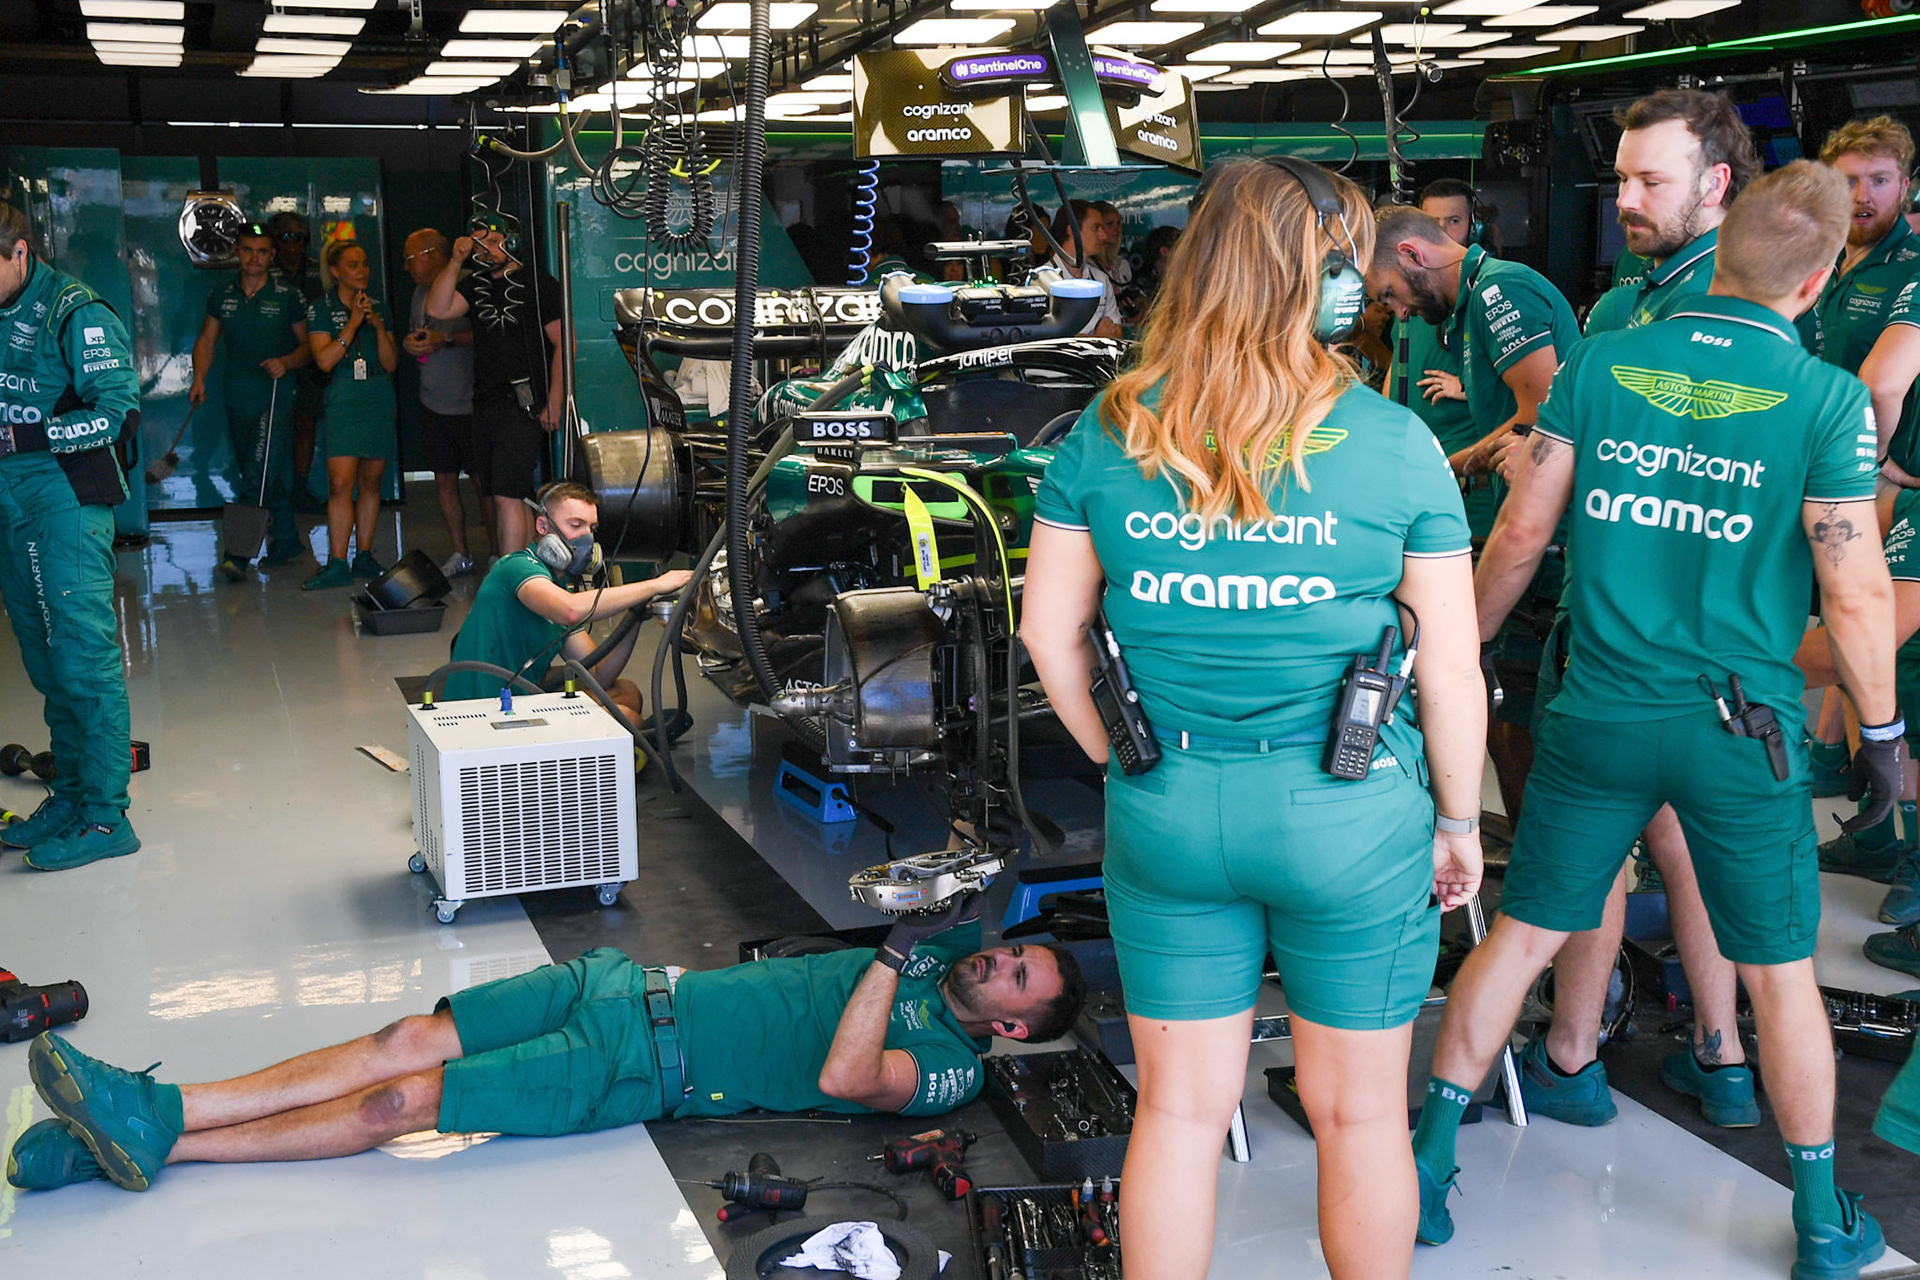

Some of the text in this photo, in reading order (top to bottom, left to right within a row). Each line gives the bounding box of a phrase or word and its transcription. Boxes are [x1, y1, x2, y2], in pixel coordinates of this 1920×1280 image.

[969, 59, 1042, 75] SentinelOne
[903, 102, 974, 120] cognizant
[907, 127, 972, 142] aramco
[1137, 129, 1178, 151] aramco
[614, 252, 759, 280] cogniza
[1485, 300, 1513, 321] EPOS
[1489, 309, 1521, 334] PIRELLI
[1690, 331, 1733, 347] BOSS
[83, 348, 111, 359] EPOS
[83, 358, 119, 373] PIRELLI
[1656, 380, 1733, 403] ASTON MARTIN
[47, 417, 109, 440] aramco
[812, 421, 872, 438] BOSS
[817, 447, 854, 459] OAKLEY
[1597, 438, 1766, 488] cognizant
[808, 474, 844, 496] EPOS
[1585, 488, 1753, 543] aramco
[1125, 511, 1338, 551] cognizant
[27, 541, 44, 597] MARTIN
[1130, 570, 1337, 610] aramco
[1372, 756, 1398, 770] BOSS
[926, 1072, 937, 1104] BOSS
